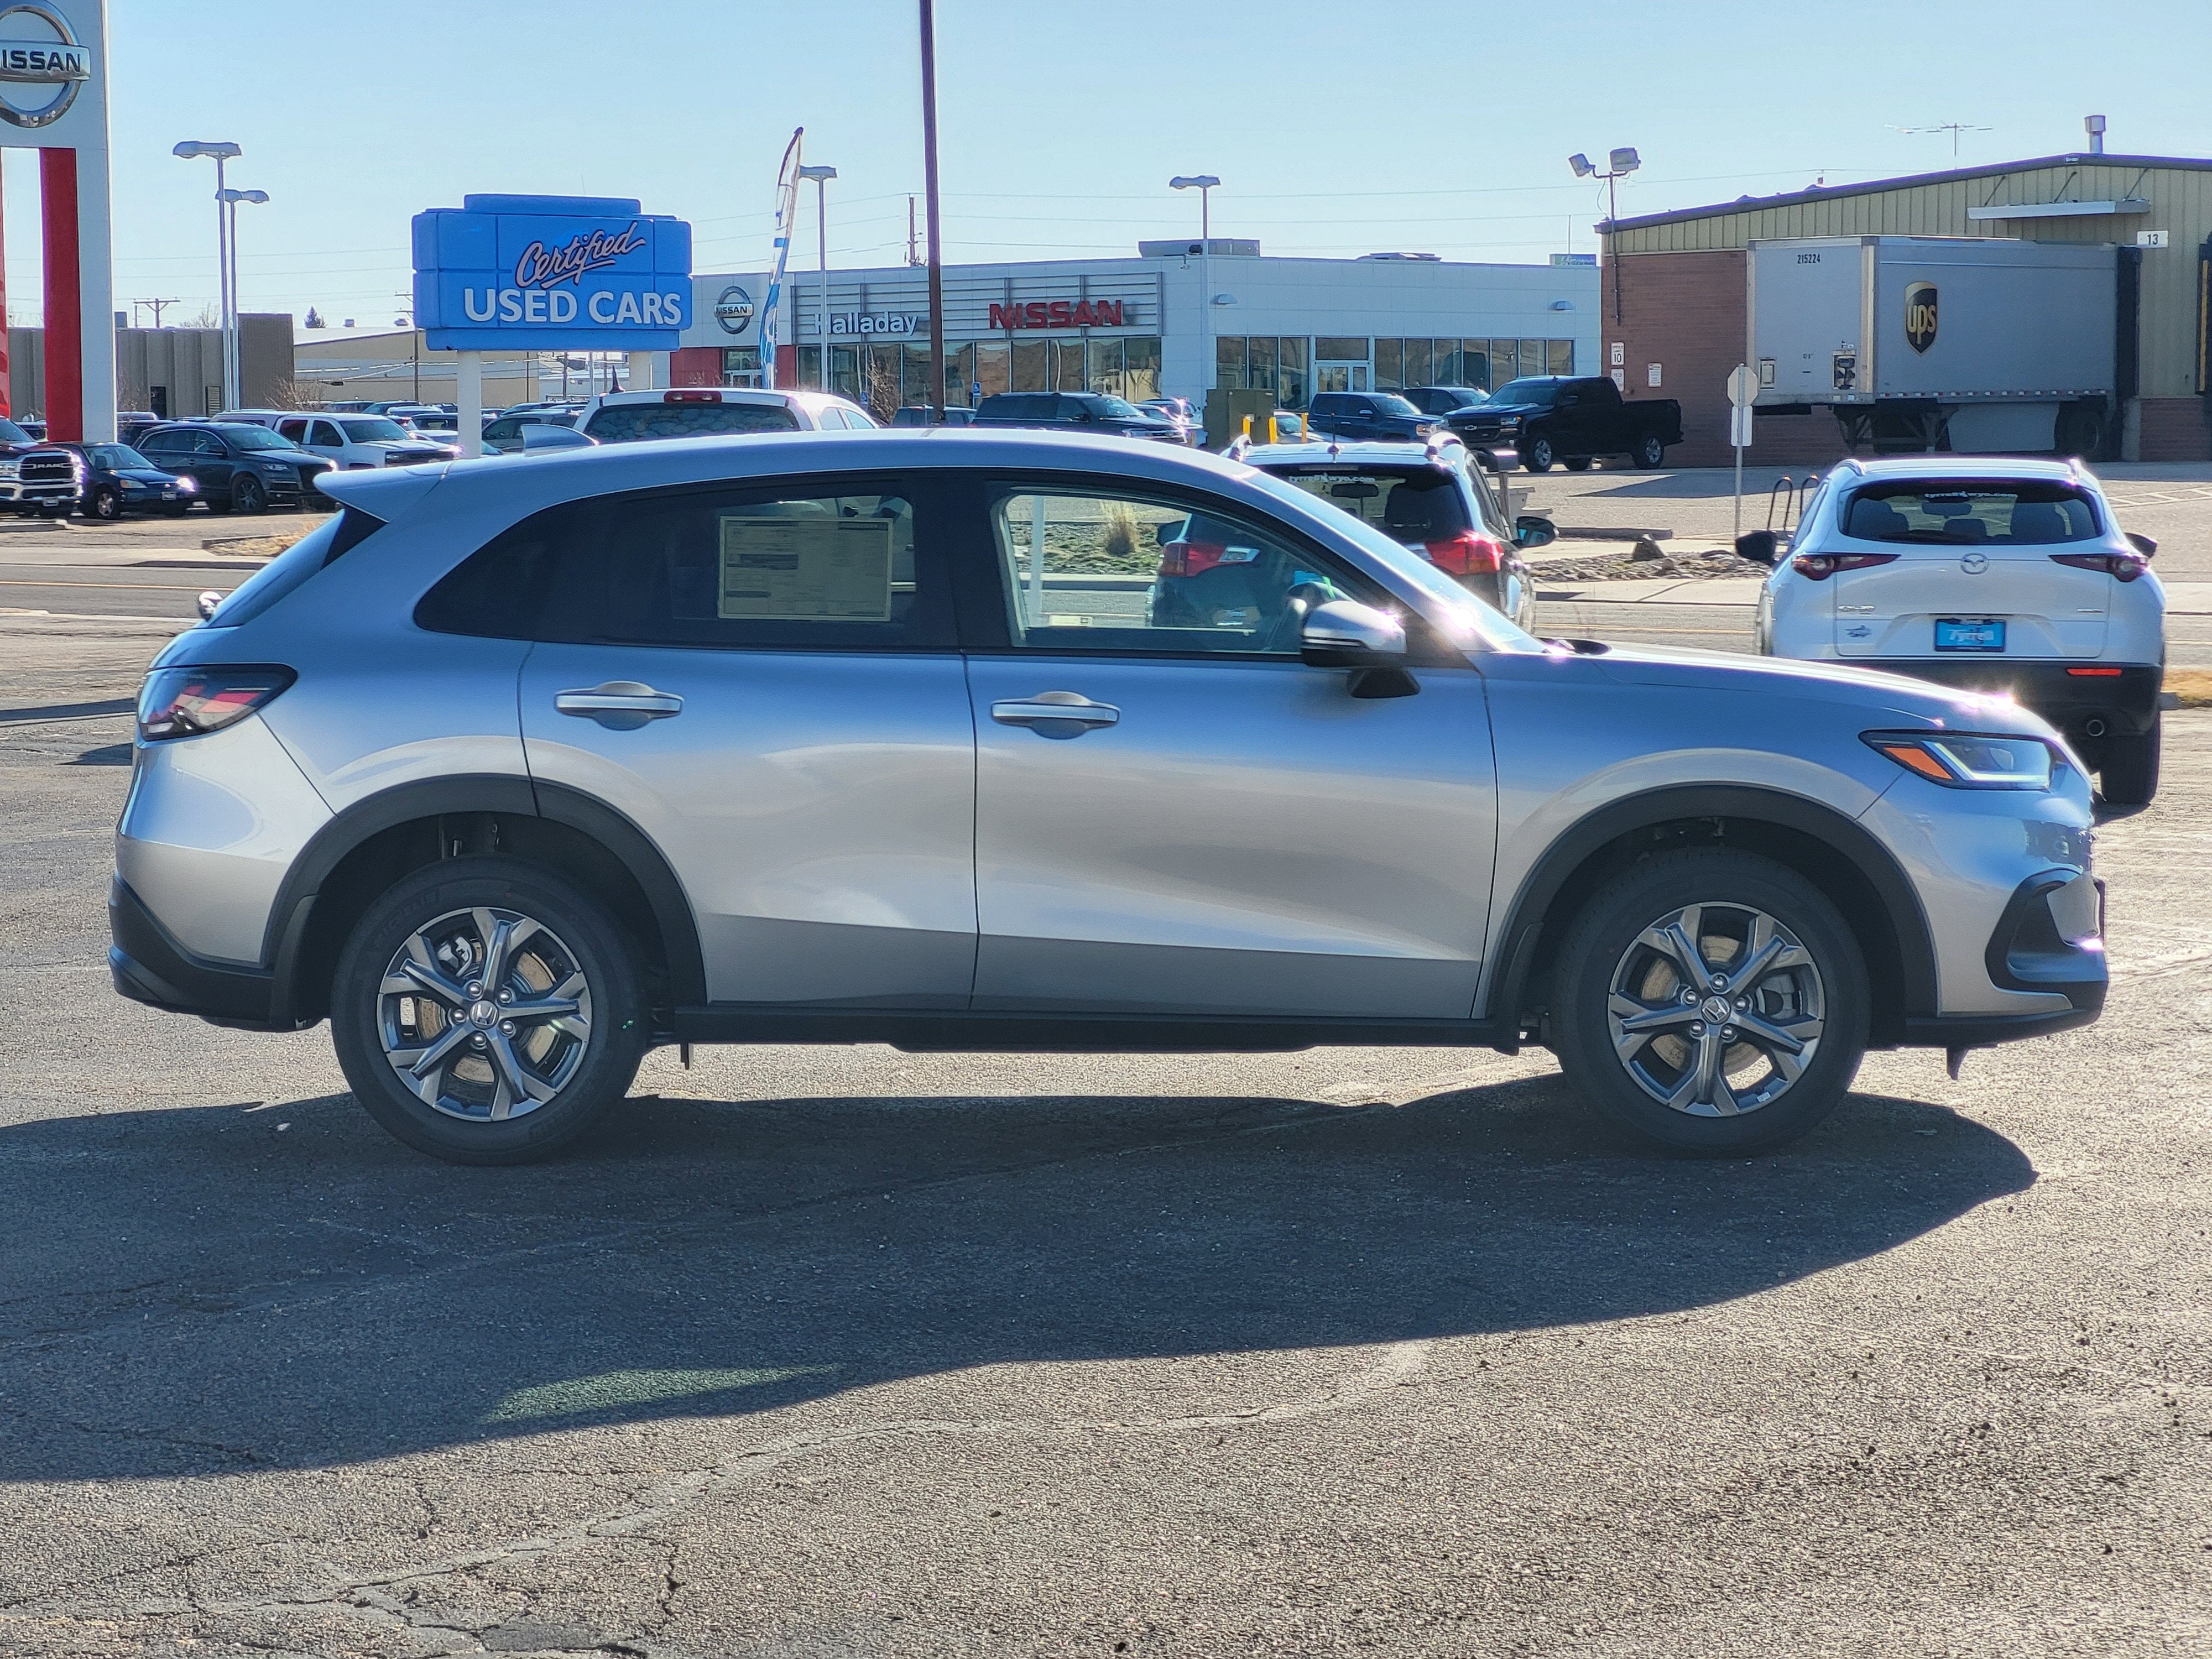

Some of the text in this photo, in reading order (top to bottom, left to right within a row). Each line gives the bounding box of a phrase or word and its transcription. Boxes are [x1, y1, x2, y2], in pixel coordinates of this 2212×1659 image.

[1, 49, 81, 72] ISSAN
[2146, 233, 2159, 245] 13
[515, 221, 646, 289] Certified
[1797, 254, 1820, 264] 215224
[464, 288, 682, 325] USED CARS
[716, 306, 748, 315] NISSAN
[989, 299, 1122, 330] NISSAN
[1907, 304, 1937, 345] ups
[1614, 353, 1622, 363] 10
